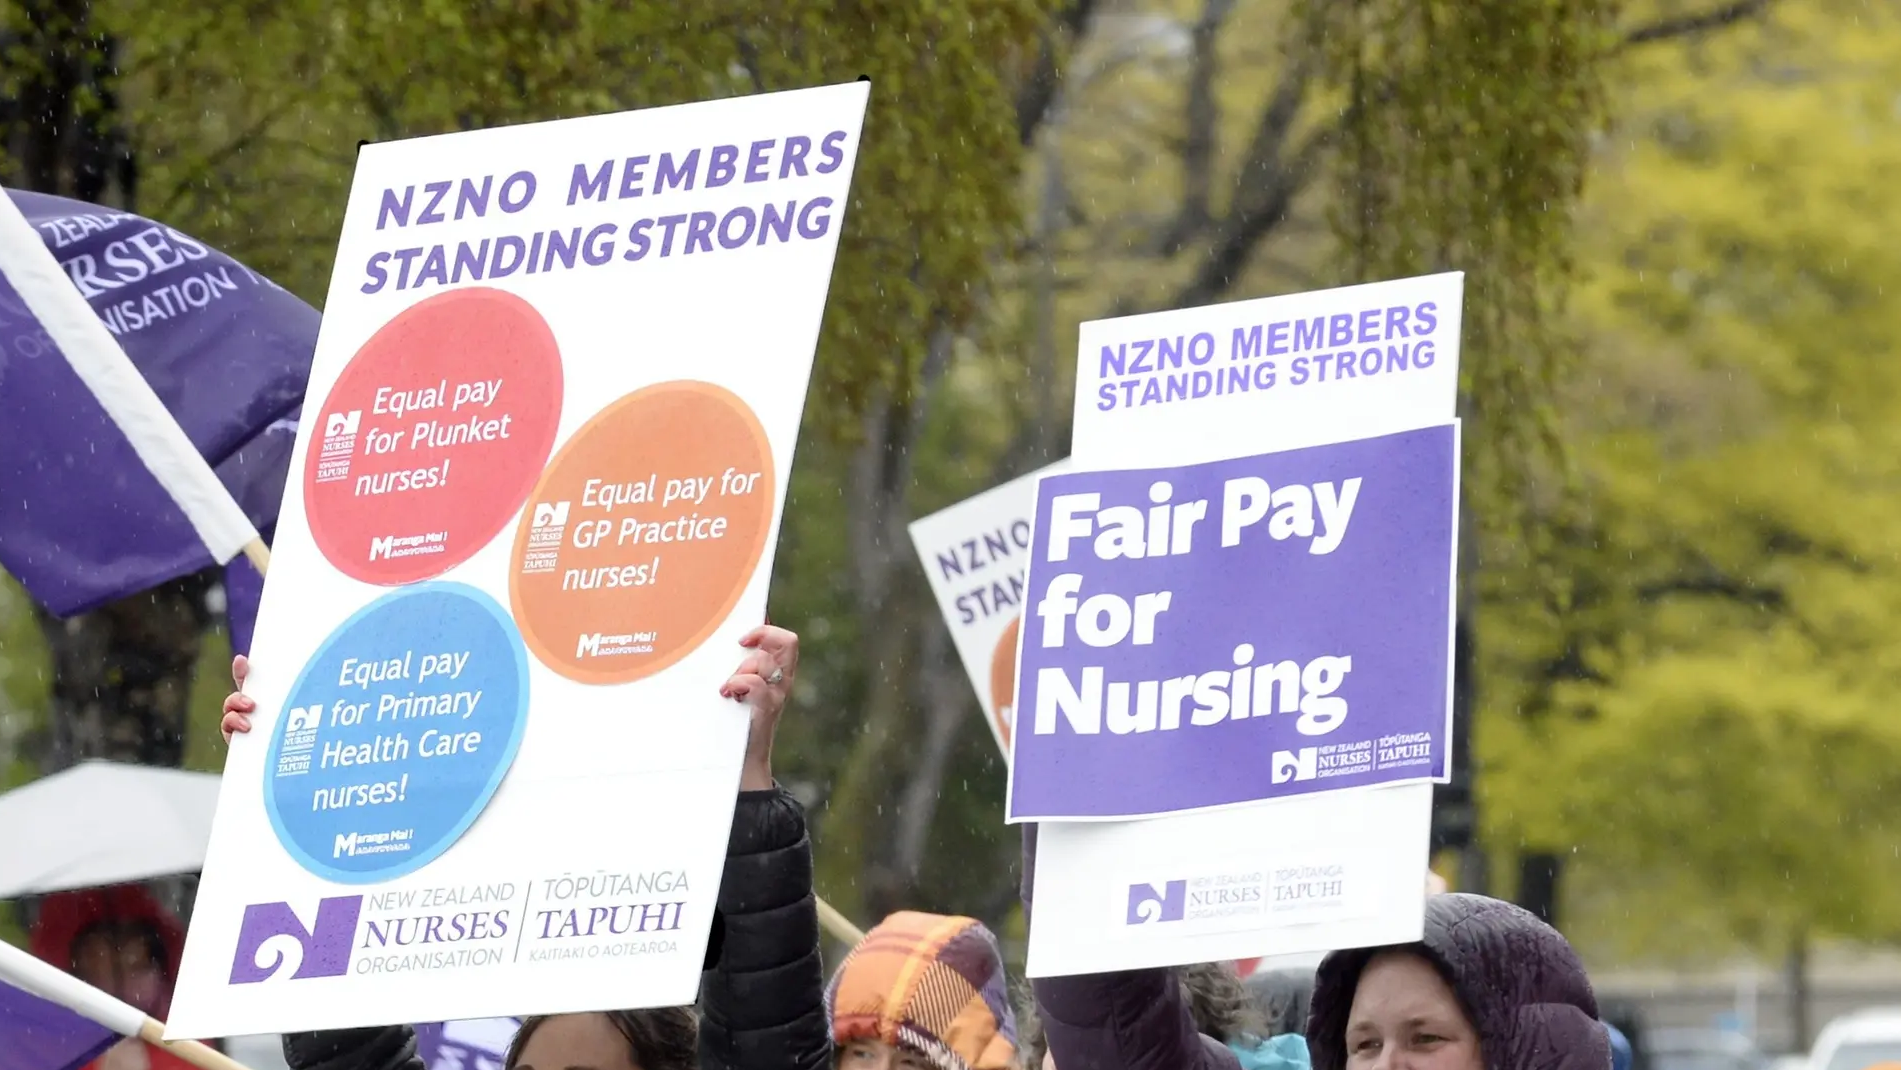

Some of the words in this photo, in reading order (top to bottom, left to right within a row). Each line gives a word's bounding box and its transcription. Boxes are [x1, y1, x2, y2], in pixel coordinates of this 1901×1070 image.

[375, 170, 537, 231] NZNO
[566, 130, 847, 205] MEMBERS
[58, 227, 209, 300] RSES
[360, 222, 618, 294] STANDING
[625, 196, 833, 261] STRONG
[99, 266, 239, 336] NISATION
[1099, 332, 1215, 379] NZNO
[1230, 301, 1438, 361] MEMBERS
[1097, 361, 1276, 411] STANDING
[1290, 340, 1436, 386] STRONG
[372, 380, 446, 418] Equal
[452, 379, 502, 411] pay
[364, 428, 405, 455] for
[411, 413, 511, 450] Plunket
[355, 459, 450, 496] nurses!
[581, 473, 656, 512] Equal
[662, 476, 713, 507] pay
[720, 467, 761, 496] for
[572, 520, 612, 548] GP
[618, 513, 727, 545] Practice
[1047, 481, 1208, 562] Fair
[1221, 476, 1363, 555] Pay
[369, 534, 424, 561] Maranga
[936, 517, 1030, 580] NZNO
[562, 556, 660, 590] nurses!
[955, 569, 1025, 625] STAN
[1038, 573, 1172, 648] for
[576, 633, 632, 658] Maranga
[338, 650, 411, 690] Equal
[418, 651, 470, 683] pay
[1034, 643, 1351, 735] Nursing
[330, 699, 371, 727] for
[376, 690, 482, 722] Primary
[320, 733, 409, 769] Health
[418, 729, 482, 757] Care
[1318, 750, 1371, 769] NURSES
[1378, 743, 1431, 762] TAPUHI
[312, 773, 408, 811] nurses!
[333, 832, 389, 858] Maranga
[369, 889, 416, 911] NEW
[421, 883, 515, 908] ZEALAND
[544, 870, 690, 901] TŌPŪTANGA
[1189, 886, 1261, 907] NURSES
[1273, 880, 1343, 902] TAPUHI
[362, 910, 510, 949] NURSES
[536, 902, 687, 939] TAPUHI
[356, 948, 503, 975] ORGANISATION
[529, 945, 585, 962] KAITIAKI
[602, 941, 678, 957] AOTEAROA
